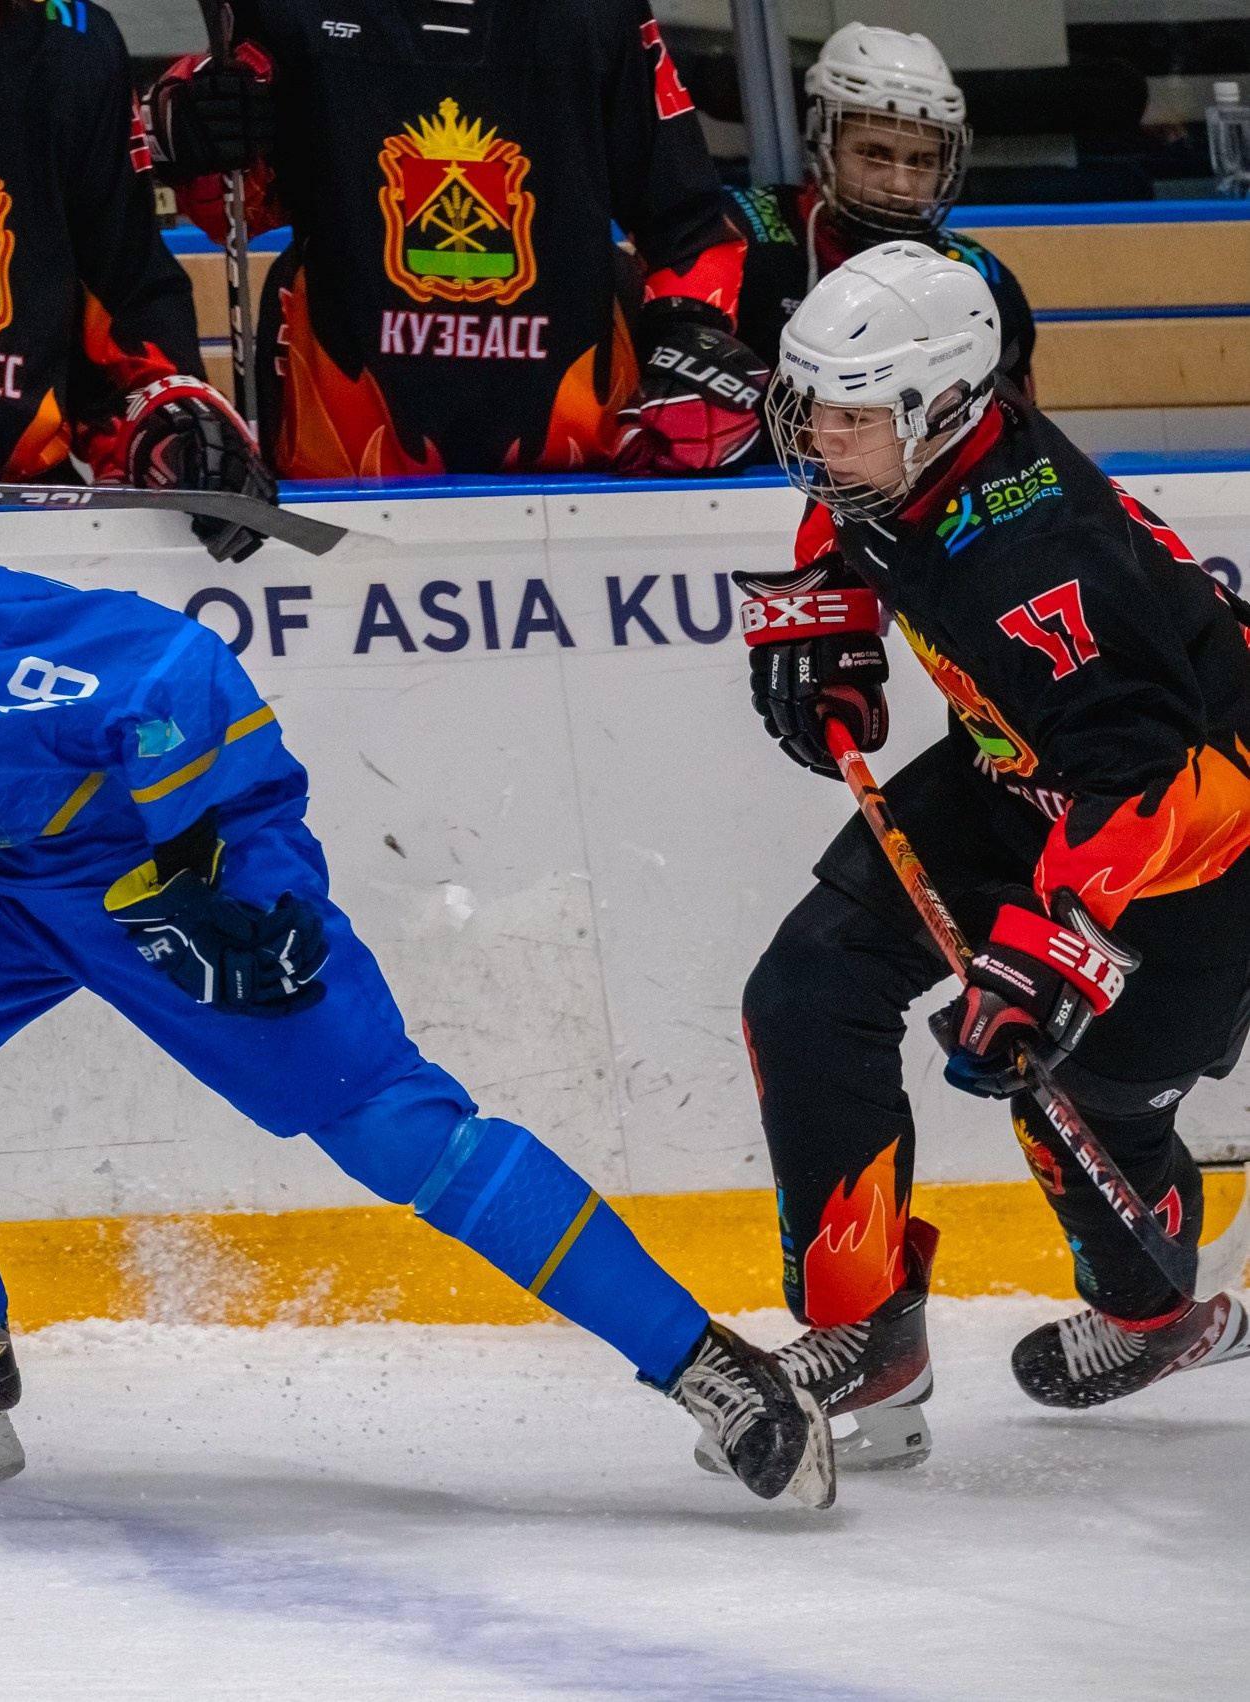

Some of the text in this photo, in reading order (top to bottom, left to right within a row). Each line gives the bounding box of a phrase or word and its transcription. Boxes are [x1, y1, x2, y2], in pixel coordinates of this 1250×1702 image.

[380, 310, 550, 360] КУЗБАСС
[785, 351, 820, 374] BAUER
[928, 341, 973, 367] BAUER
[981, 457, 1051, 495] Дети Азии
[986, 467, 1058, 516] 2023
[184, 585, 313, 657] OF
[352, 577, 577, 655] ASIA
[996, 579, 1100, 681] 17
[799, 655, 811, 684] X92
[984, 965, 1037, 997] PERFORMANCE
[988, 958, 1035, 986] PRO CARBON
[1055, 998, 1074, 1027] X92
